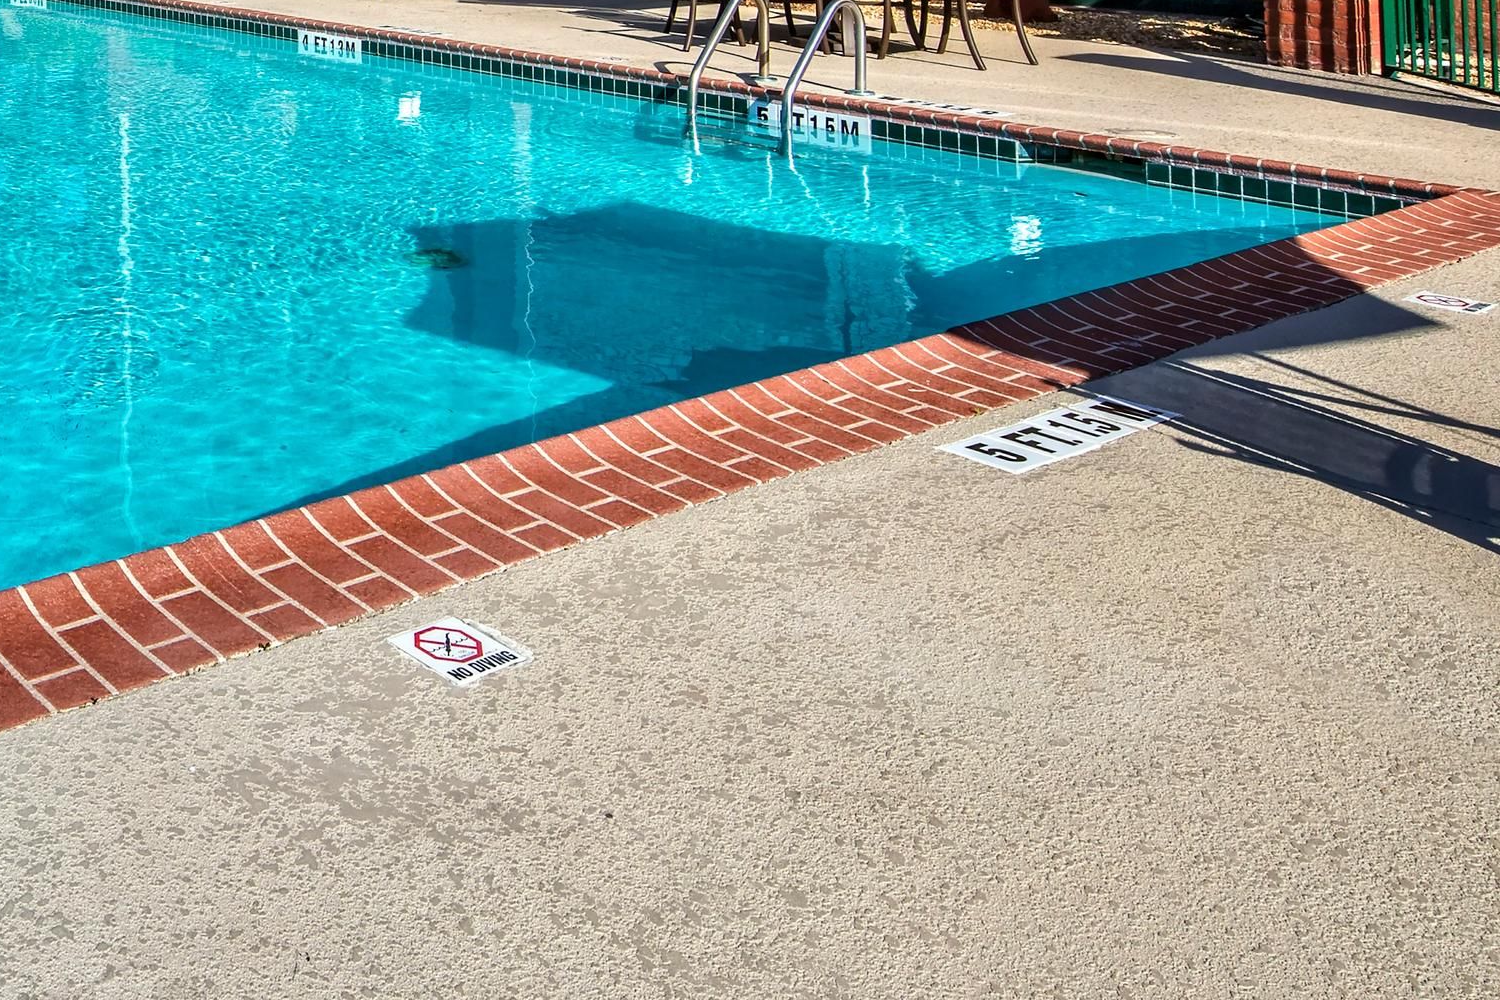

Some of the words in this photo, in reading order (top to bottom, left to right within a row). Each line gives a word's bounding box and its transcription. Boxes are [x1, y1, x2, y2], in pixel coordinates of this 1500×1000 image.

[756, 106, 769, 123] 5
[964, 442, 1027, 463] 5
[447, 667, 473, 681] NO
[467, 650, 518, 673] DIVING
